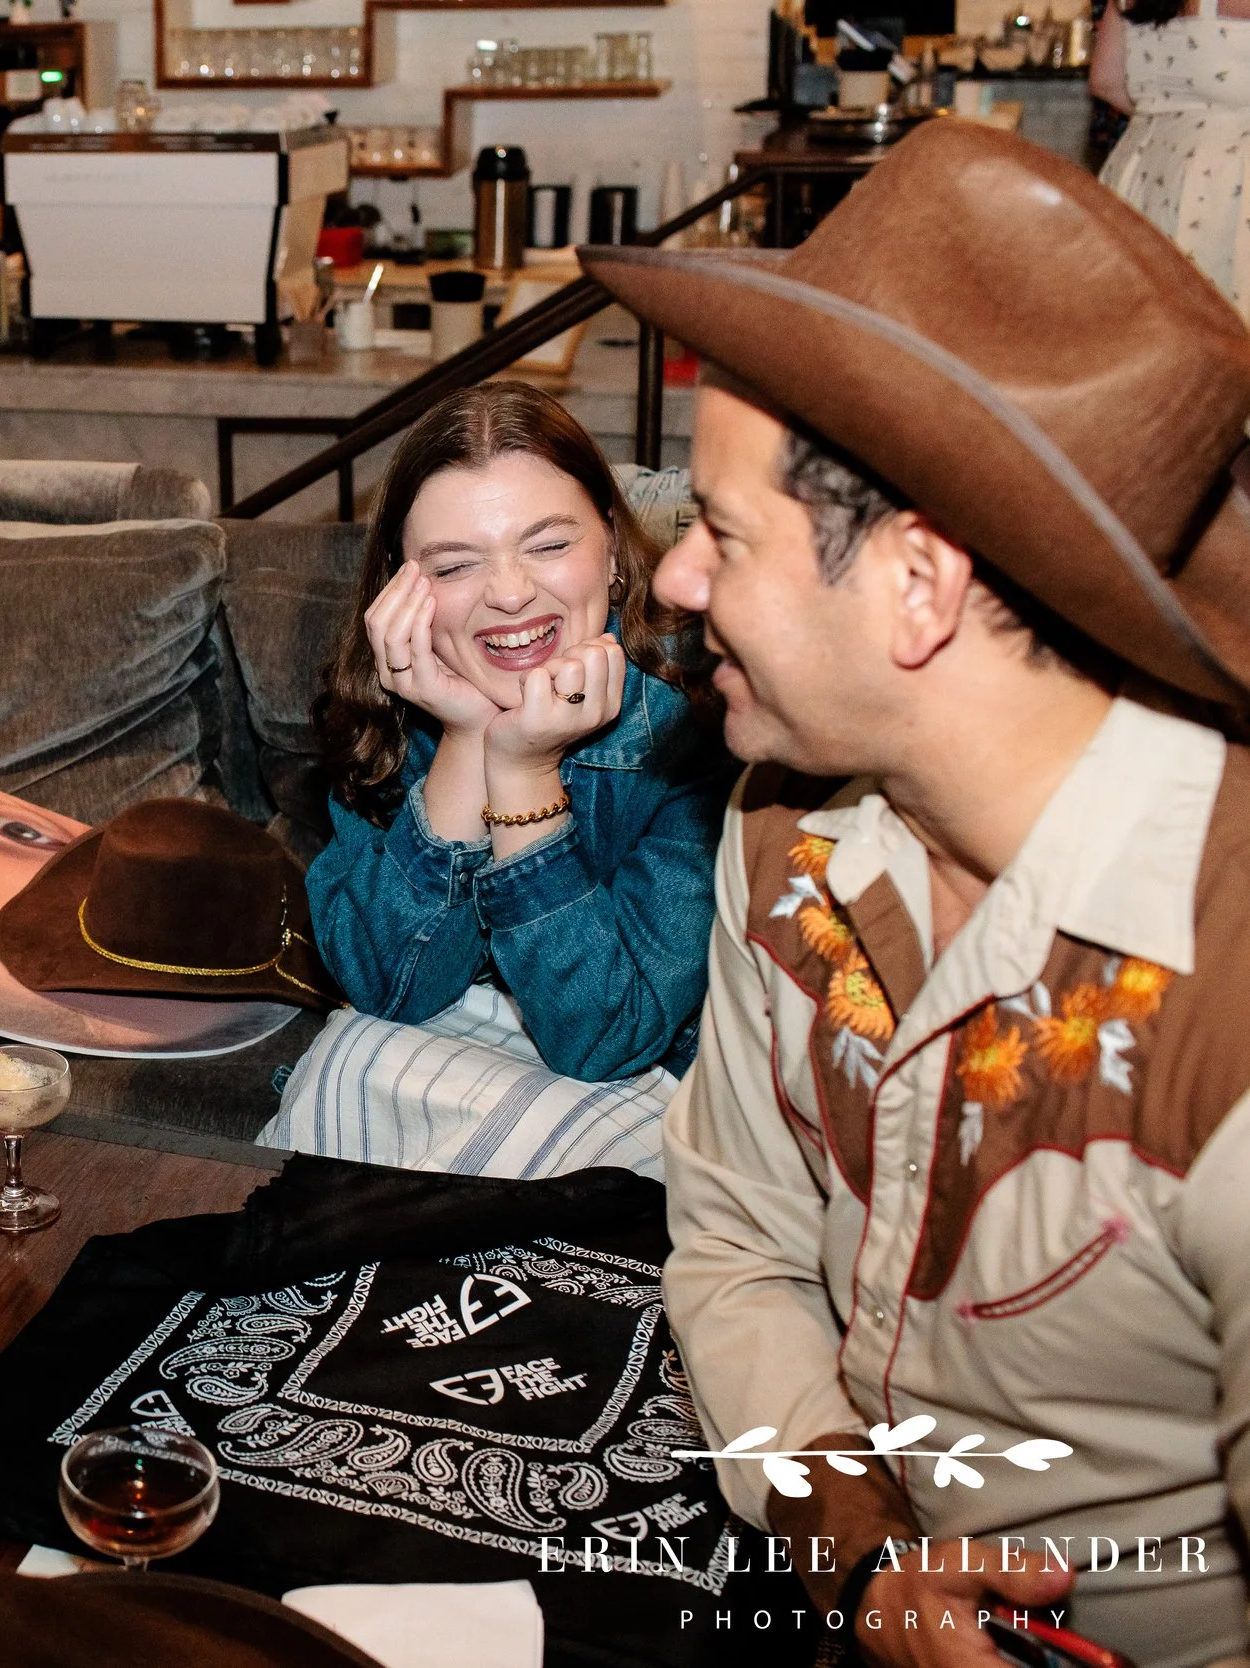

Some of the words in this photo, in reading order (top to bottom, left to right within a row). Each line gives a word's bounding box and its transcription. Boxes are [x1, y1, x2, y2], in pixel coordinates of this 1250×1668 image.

[381, 1293, 448, 1334] FIGHT
[409, 1311, 457, 1338] THE
[406, 1323, 466, 1349] FACE
[499, 1357, 561, 1380] FACE
[509, 1370, 559, 1390] THE
[518, 1373, 588, 1401] FIGHT
[642, 1492, 687, 1520] FACE
[657, 1500, 708, 1533] FIGHT
